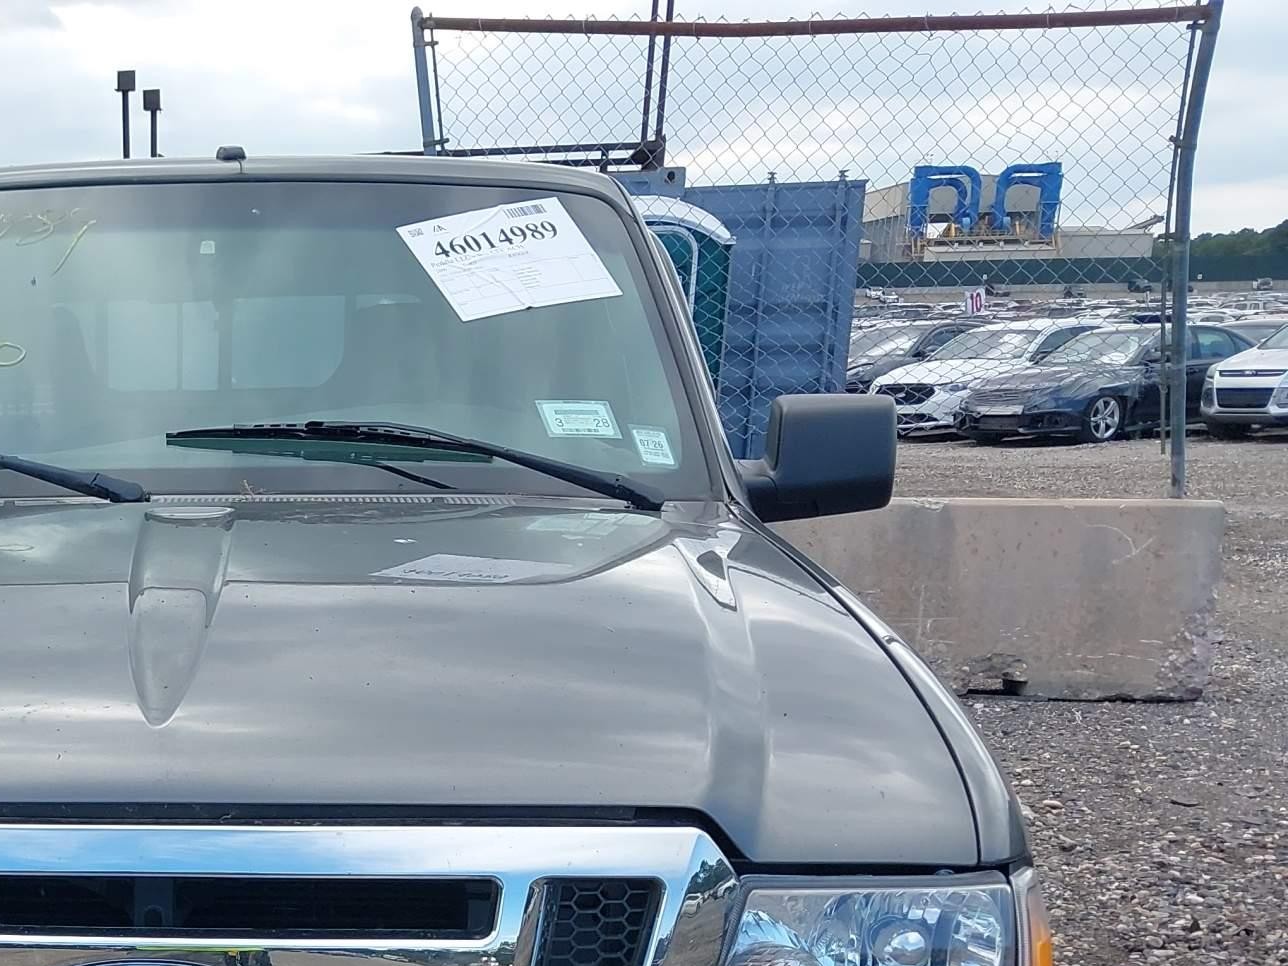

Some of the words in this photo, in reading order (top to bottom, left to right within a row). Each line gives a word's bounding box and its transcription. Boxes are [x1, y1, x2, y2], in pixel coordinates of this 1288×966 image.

[433, 220, 558, 258] 46014989
[970, 292, 982, 313] 10
[555, 418, 564, 427] 3
[594, 419, 610, 428] 28
